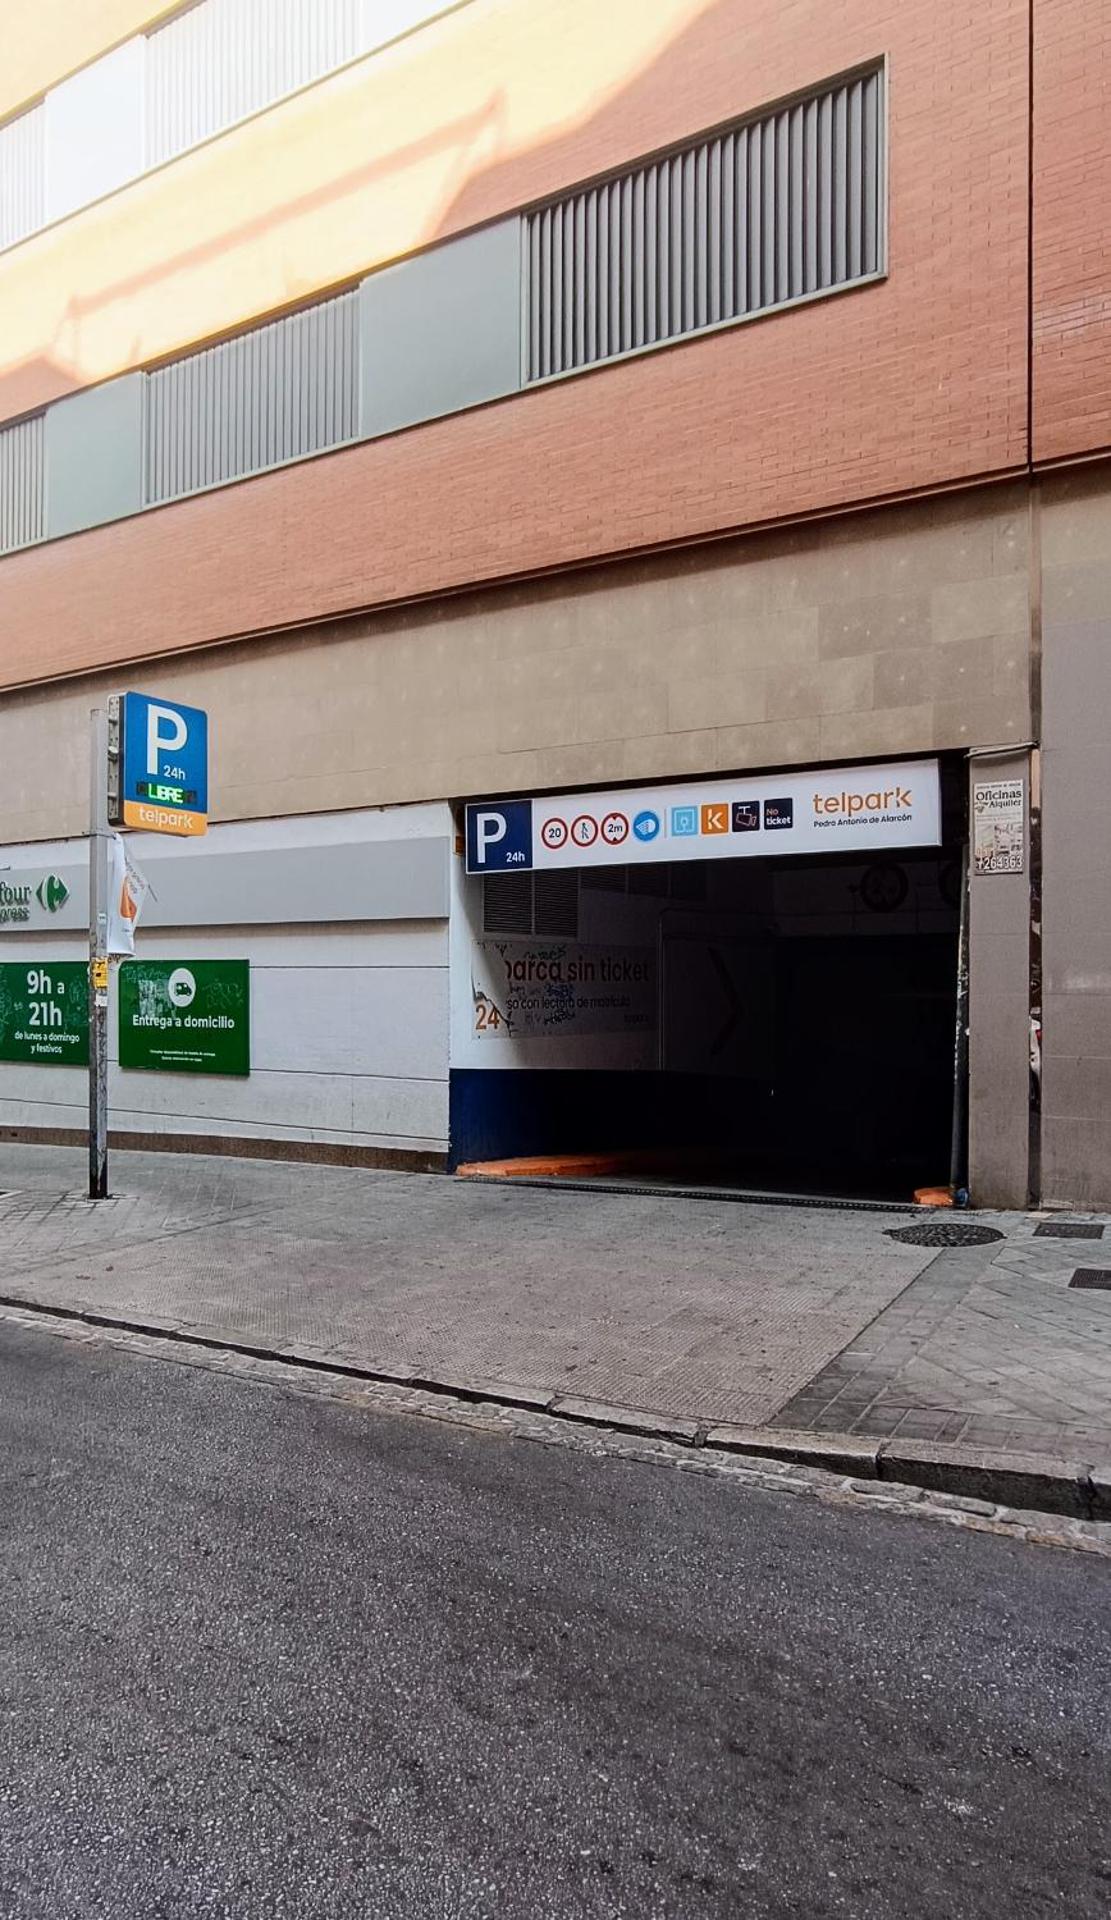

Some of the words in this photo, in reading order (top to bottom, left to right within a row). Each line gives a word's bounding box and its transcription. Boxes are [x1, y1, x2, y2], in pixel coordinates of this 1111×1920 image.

[147, 704, 188, 775] P
[163, 765, 186, 781] 24h
[148, 783, 184, 803] LIBRE
[976, 790, 1022, 801] Oficinas
[813, 787, 912, 817] telpark
[989, 799, 1021, 809] Alquiler
[139, 807, 193, 829] telpark
[766, 808, 779, 816] No
[766, 816, 791, 826] ticket
[813, 820, 836, 829] Pedro
[837, 816, 868, 826] Antonio
[868, 815, 880, 824] de
[880, 812, 913, 823] Alarcón
[548, 828, 562, 839] 20
[607, 823, 623, 834] 2m
[476, 812, 507, 864] P
[506, 851, 526, 863] 24h
[567, 956, 595, 982] sin
[600, 956, 649, 982] ticket
[27, 970, 52, 994] 9h
[57, 982, 65, 994] a
[29, 1001, 62, 1026] 21h
[132, 1014, 173, 1029] Entrega
[174, 1018, 182, 1027] a
[184, 1015, 235, 1029] domicilio
[15, 1031, 24, 1040] de
[24, 1031, 42, 1040] lunes
[49, 1032, 80, 1044] domingo
[31, 1045, 36, 1054] y
[36, 1043, 62, 1053] festivos
